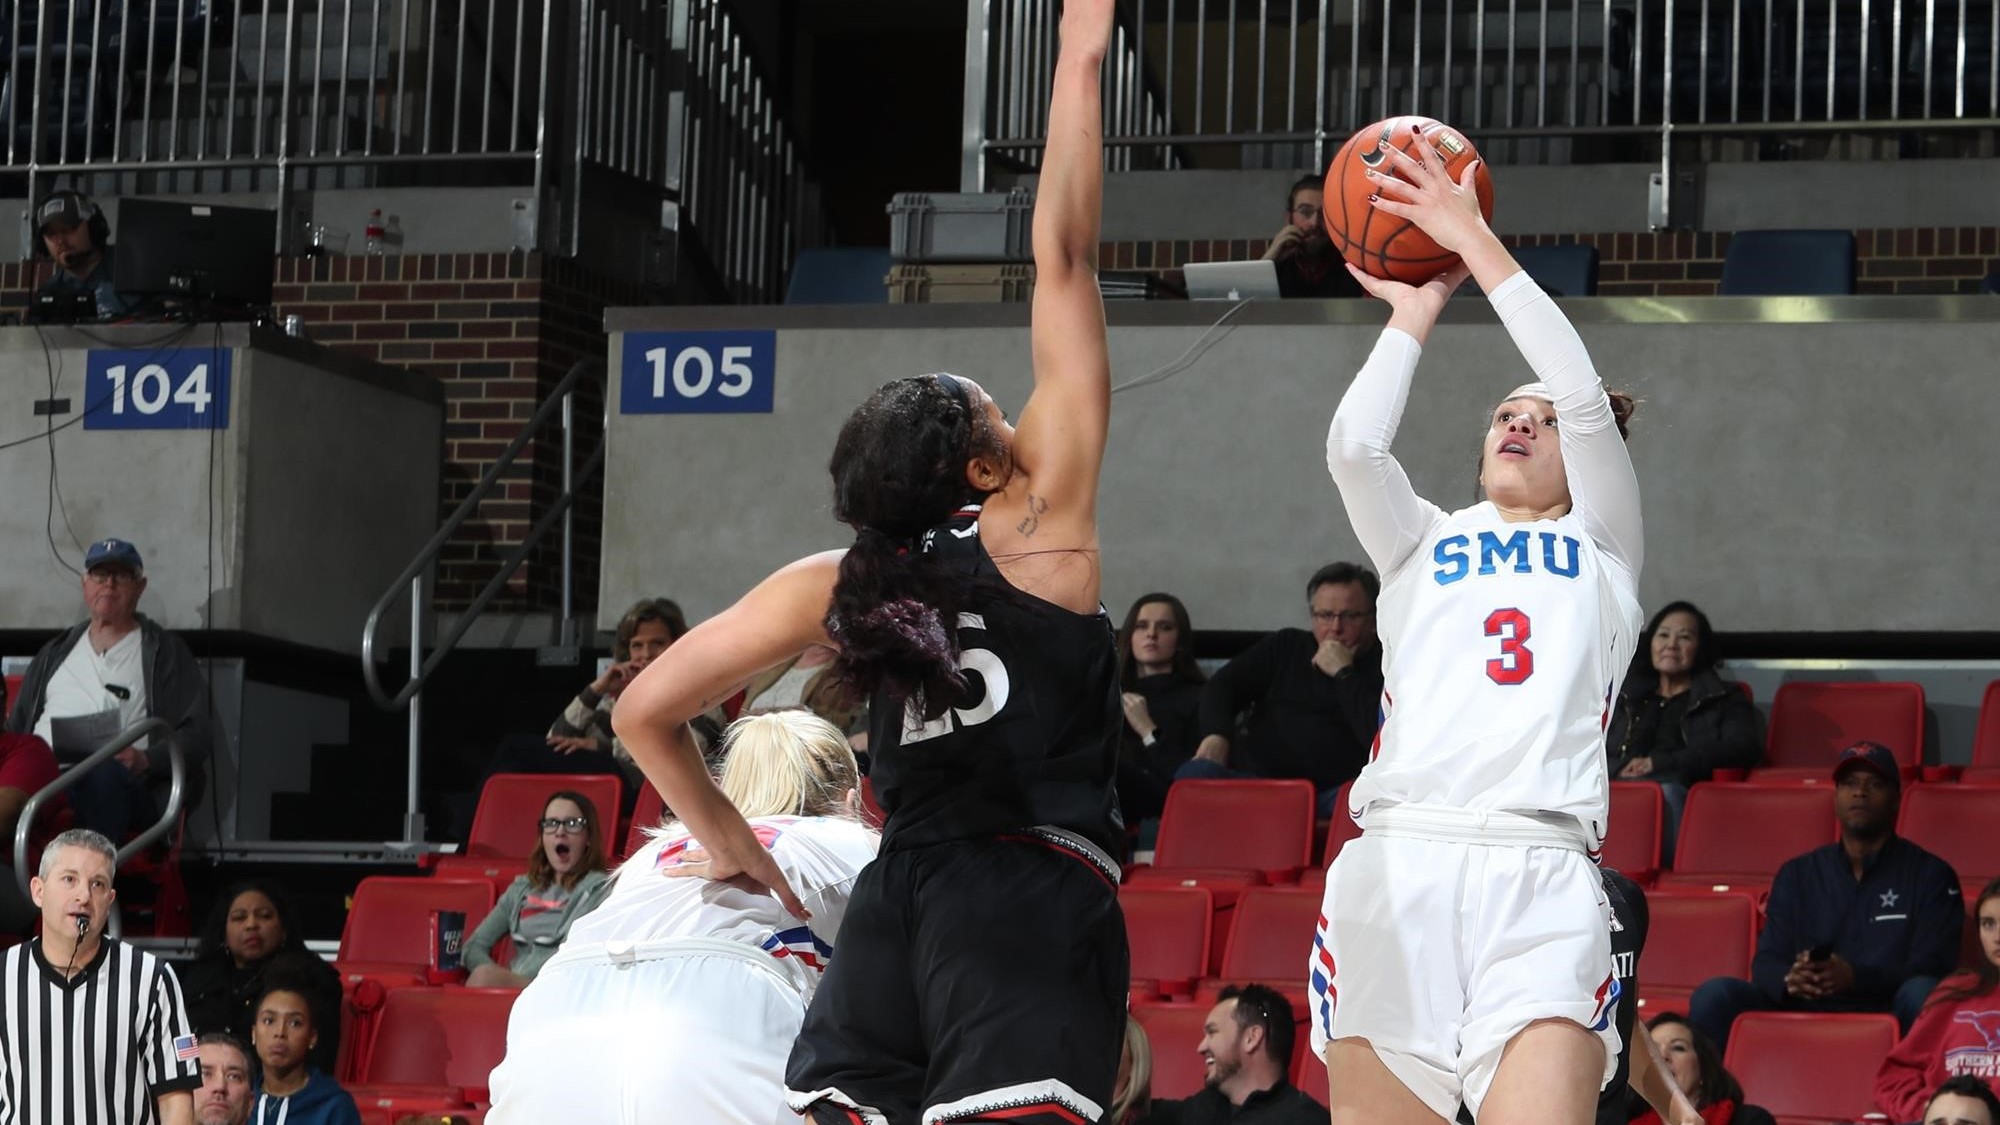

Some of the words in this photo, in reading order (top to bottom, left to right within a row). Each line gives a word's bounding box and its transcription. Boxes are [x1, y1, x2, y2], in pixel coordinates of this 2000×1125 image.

[106, 364, 212, 415] 104
[645, 346, 753, 398] 105
[1434, 530, 1581, 586] SMU
[1483, 607, 1535, 686] 3
